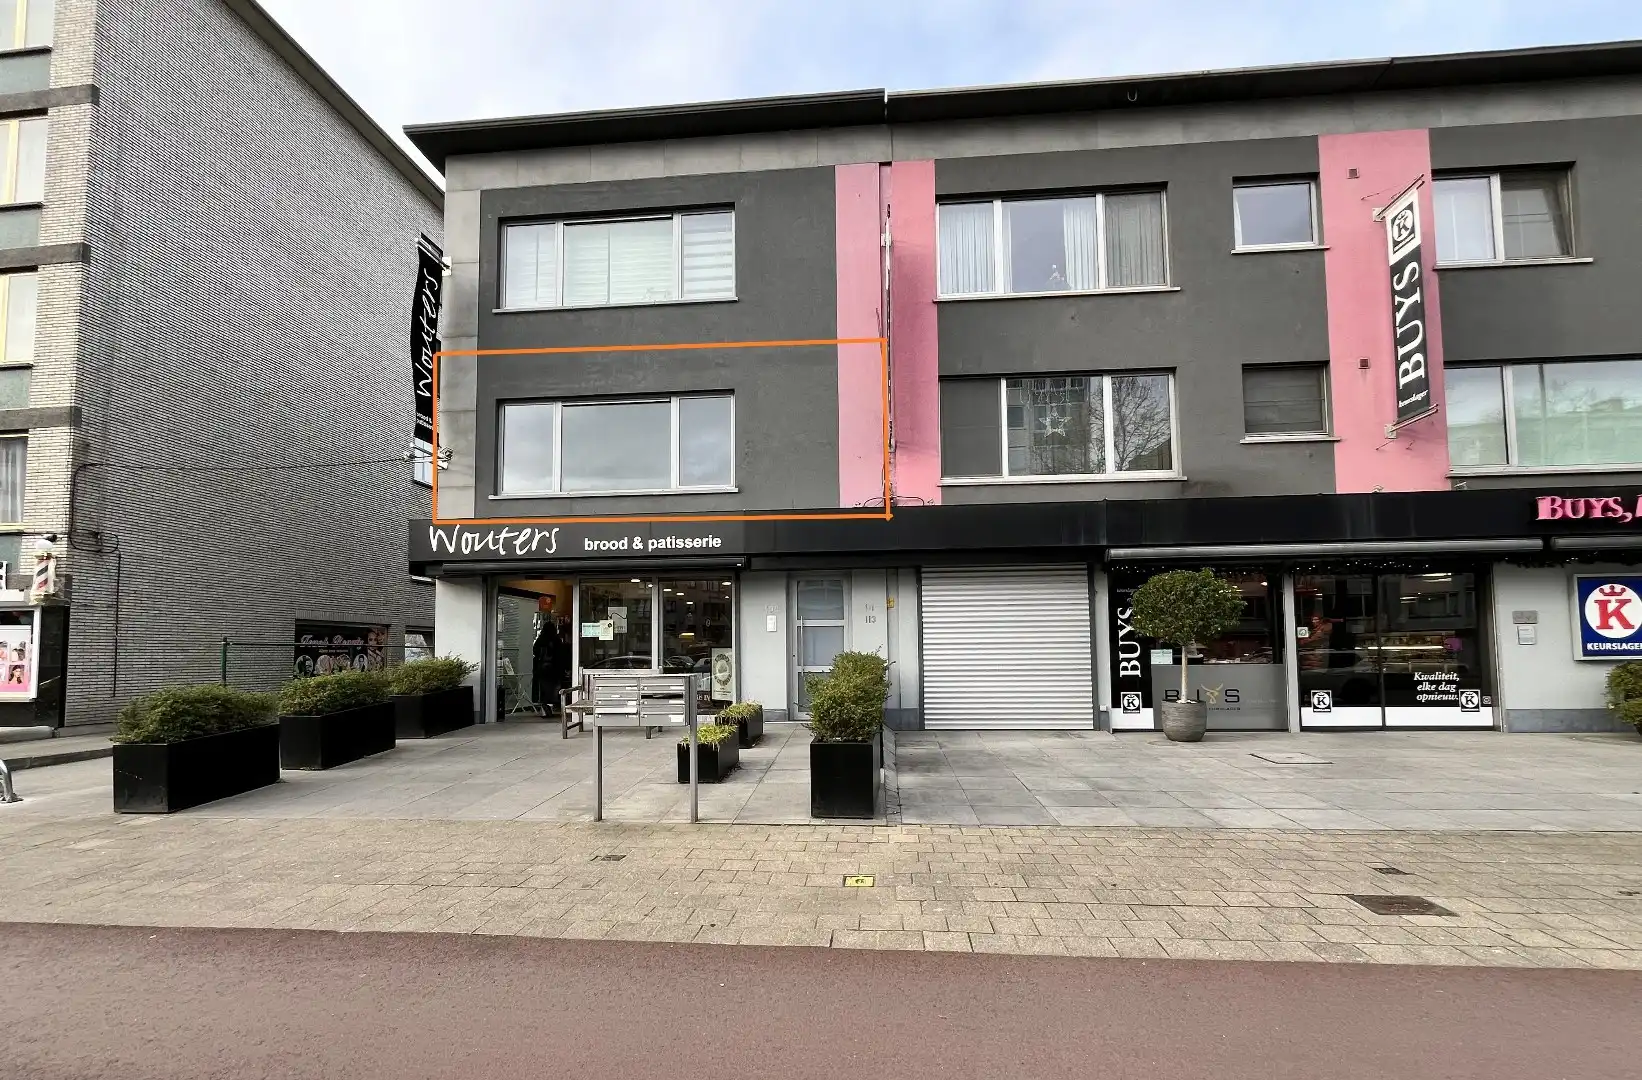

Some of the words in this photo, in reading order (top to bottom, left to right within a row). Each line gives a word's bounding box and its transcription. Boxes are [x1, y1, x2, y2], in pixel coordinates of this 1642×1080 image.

[416, 268, 438, 397] Wouters
[1393, 261, 1425, 389] BUYS
[1536, 495, 1632, 523] BUYS,
[429, 524, 560, 555] Wouters
[584, 536, 630, 551] brood
[632, 537, 644, 550] &
[647, 535, 722, 552] patisserie
[1594, 599, 1635, 630] K
[1414, 672, 1460, 681] Kwaliteit,
[1417, 682, 1436, 691] elke
[1438, 682, 1457, 692] dag
[1416, 692, 1459, 702] opnieuw.
